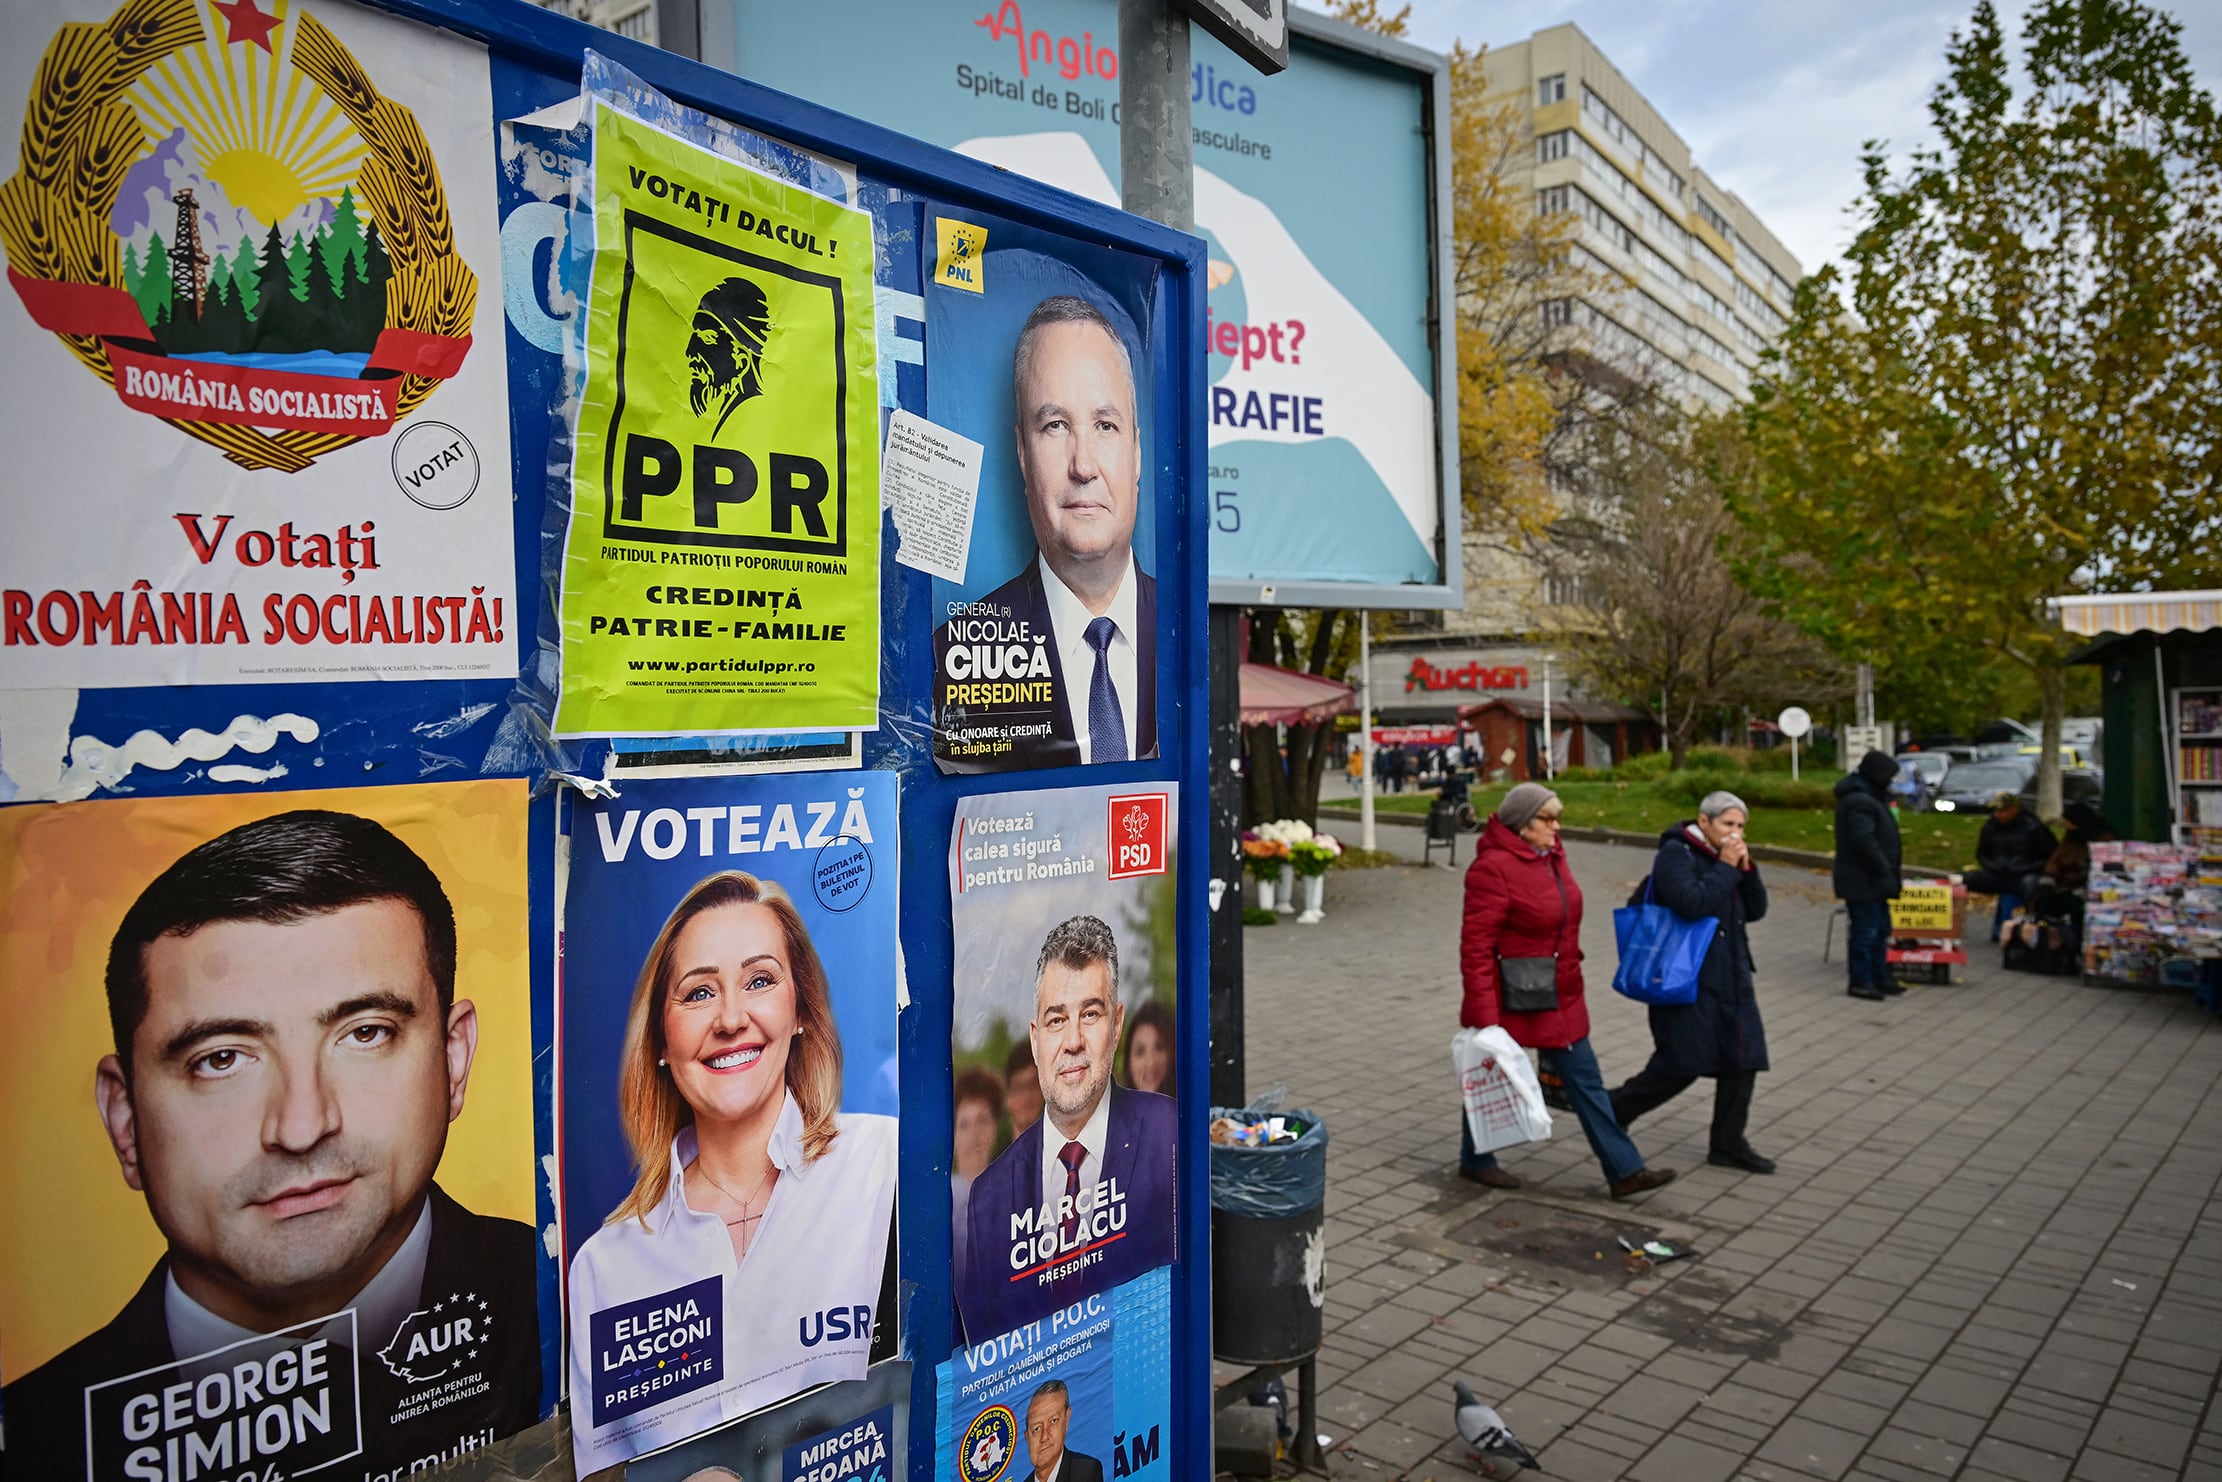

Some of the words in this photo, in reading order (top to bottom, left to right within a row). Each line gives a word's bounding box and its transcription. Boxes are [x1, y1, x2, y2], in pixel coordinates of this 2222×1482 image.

[956, 64, 1025, 101] Spital
[1032, 85, 1058, 110] de
[1066, 92, 1105, 121] Boli
[1112, 103, 1272, 160] Casculare
[628, 165, 729, 227] VOTAȚI
[738, 211, 823, 256] DACUL
[829, 239, 837, 258] !
[946, 264, 973, 283] PNL
[1208, 306, 1306, 370] iept?
[125, 365, 245, 412] ROMÂNIA
[249, 388, 389, 421] SOCIALISTĂ
[1209, 386, 1324, 435] RAFIE
[892, 432, 926, 451] mandatului
[934, 449, 966, 468] depunerea
[894, 422, 905, 432] Art.
[907, 427, 916, 436] 82
[921, 433, 949, 451] Validarea
[404, 440, 467, 489] VOTAT
[621, 433, 829, 538] PPR
[173, 512, 381, 586] Votați
[601, 546, 657, 564] PARTIDUL
[661, 552, 731, 571] PATRIOȚII
[735, 556, 804, 573] POPORULUI
[807, 559, 848, 576] ROMÂN
[2, 579, 250, 648] ROMÂNIA
[263, 585, 504, 646] SOCIALISTĂ!
[645, 585, 802, 618] CREDINȚĂ
[946, 601, 1000, 617] GENERAL
[1001, 606, 1011, 618] (R)
[948, 620, 1029, 642] NICOLAE
[628, 658, 816, 674] www.partidulppr.ro
[945, 635, 1052, 681] CIUCĂ
[1405, 657, 1529, 693] Auchan
[946, 682, 1052, 711] PREȘEDINTE
[950, 744, 960, 756] în
[962, 741, 991, 756] slujba
[993, 740, 1012, 755] țării
[960, 728, 1000, 741] ONOARE
[1000, 726, 1008, 743] și
[1009, 721, 1052, 740] CREDINȚĂ
[595, 787, 874, 863] VOTEAZĂ
[967, 811, 1034, 836] Votează
[817, 857, 849, 880] POZIȚIA
[853, 851, 864, 862] PE
[965, 841, 1009, 862] calea
[1012, 833, 1062, 860] sigură
[1120, 843, 1151, 868] PSD
[821, 865, 865, 890] BULETINUL
[830, 886, 842, 898] DE
[842, 879, 860, 894] VOT
[965, 864, 1023, 892] pentru
[1027, 855, 1095, 881] România
[1010, 1177, 1126, 1241] MARCEL
[1009, 1203, 1127, 1271] CIOLACU
[1038, 1250, 1104, 1287] PREȘEDINTE
[407, 1317, 474, 1362] AUR
[615, 1298, 700, 1343] ELENA
[799, 1304, 871, 1348] USR
[964, 1319, 1041, 1374] VOTAȚI
[1052, 1293, 1106, 1335] P.O.C.
[603, 1317, 712, 1373] LASCONI
[961, 1370, 1006, 1398] PARTIDUL
[1007, 1344, 1059, 1375] OAMENILOR
[1060, 1319, 1110, 1353] CREDINCIOȘI
[122, 1338, 328, 1442] GEORGE
[390, 1403, 430, 1425] UNIREA
[431, 1381, 491, 1410] ROMÂNILOR
[398, 1386, 442, 1409] ALIANȚA
[444, 1371, 482, 1393] PENTRU
[605, 1358, 713, 1408] PREȘEDINTE
[979, 1391, 987, 1403] O
[123, 1387, 331, 1482] SIMION
[800, 1421, 878, 1469] MIRCEA
